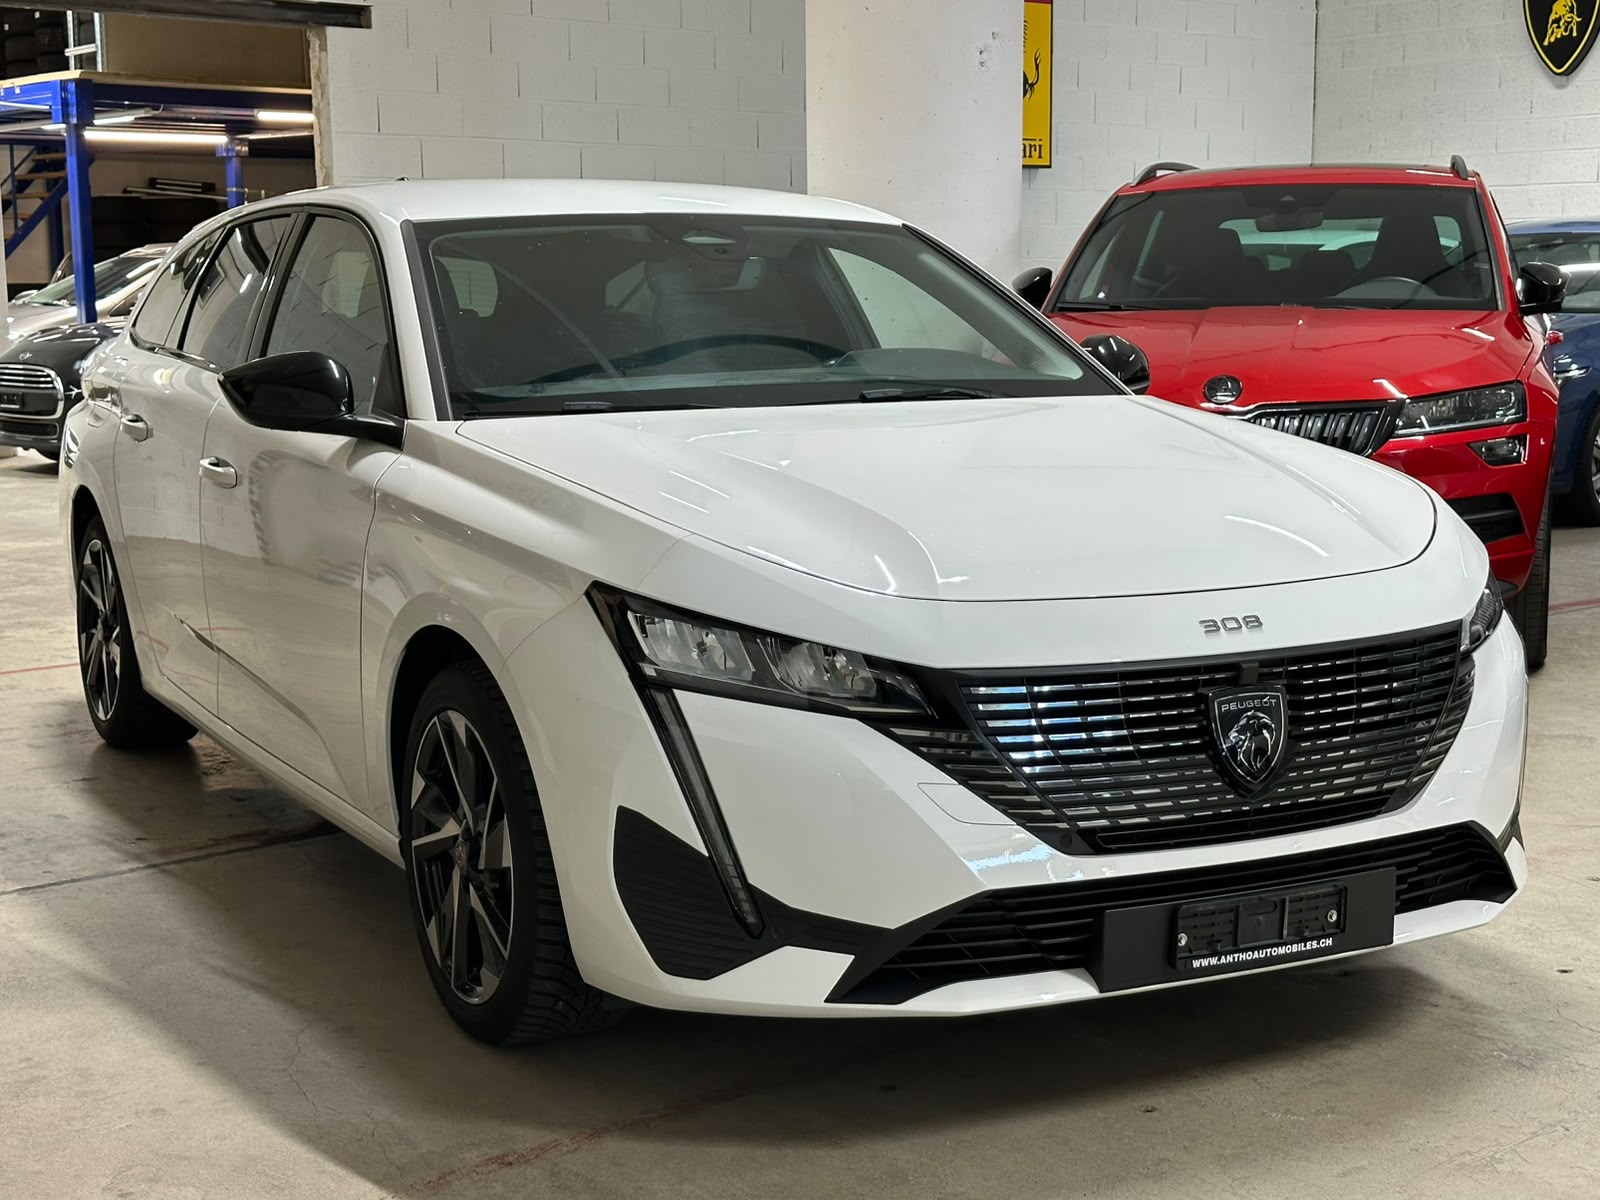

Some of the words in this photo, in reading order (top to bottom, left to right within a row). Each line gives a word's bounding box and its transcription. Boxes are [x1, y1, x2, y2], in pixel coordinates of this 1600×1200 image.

[1199, 614, 1263, 634] 308
[1221, 696, 1277, 712] PEUGEOT
[1192, 937, 1333, 968] WWW.ANTHOAUTOMOBILES.CH
